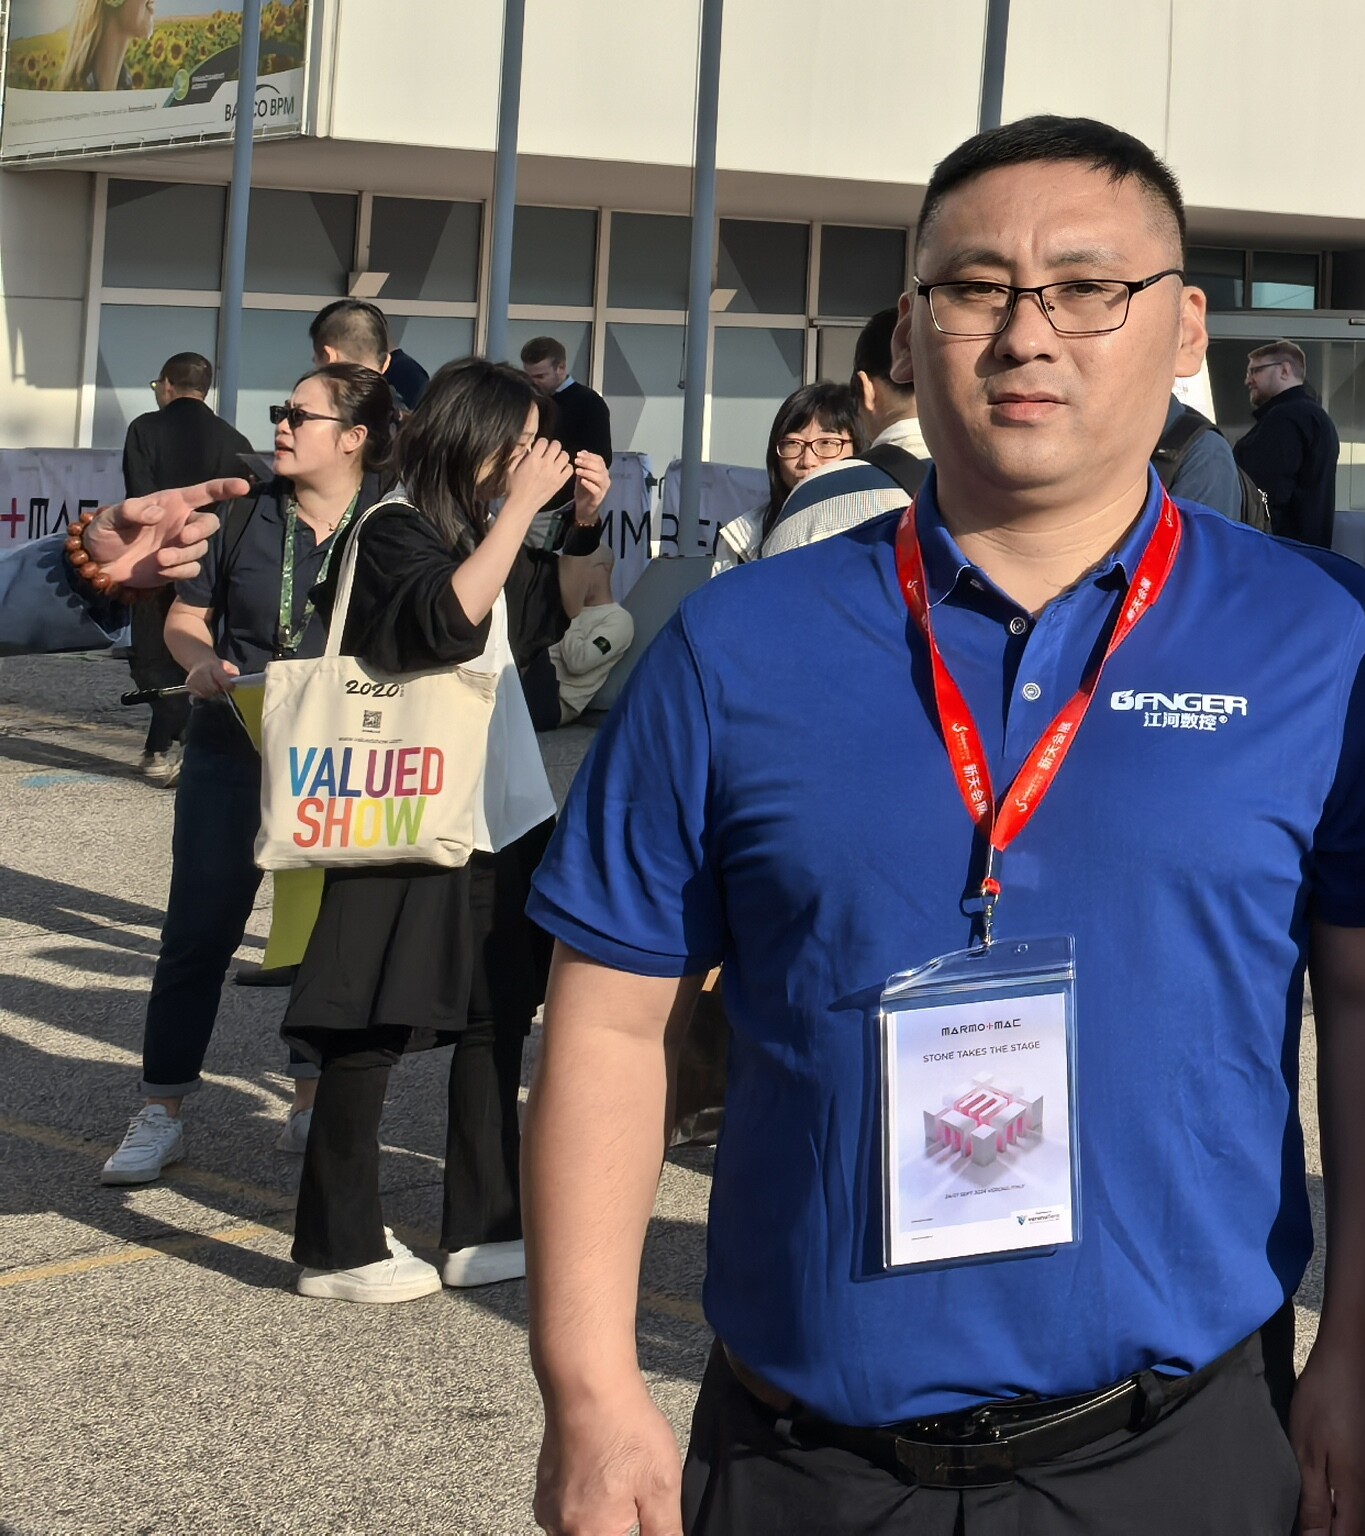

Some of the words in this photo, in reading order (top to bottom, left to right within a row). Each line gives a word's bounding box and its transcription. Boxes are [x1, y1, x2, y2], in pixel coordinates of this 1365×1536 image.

[270, 96, 294, 116] BPM
[345, 680, 400, 698] 2020
[289, 746, 445, 798] VALUED
[293, 796, 427, 848] SHOW
[941, 1018, 1022, 1037] MARMO+MAC
[923, 1051, 954, 1063] STONE
[957, 1047, 987, 1059] TAKES
[990, 1044, 1008, 1054] THE
[1010, 1041, 1040, 1051] STAGE
